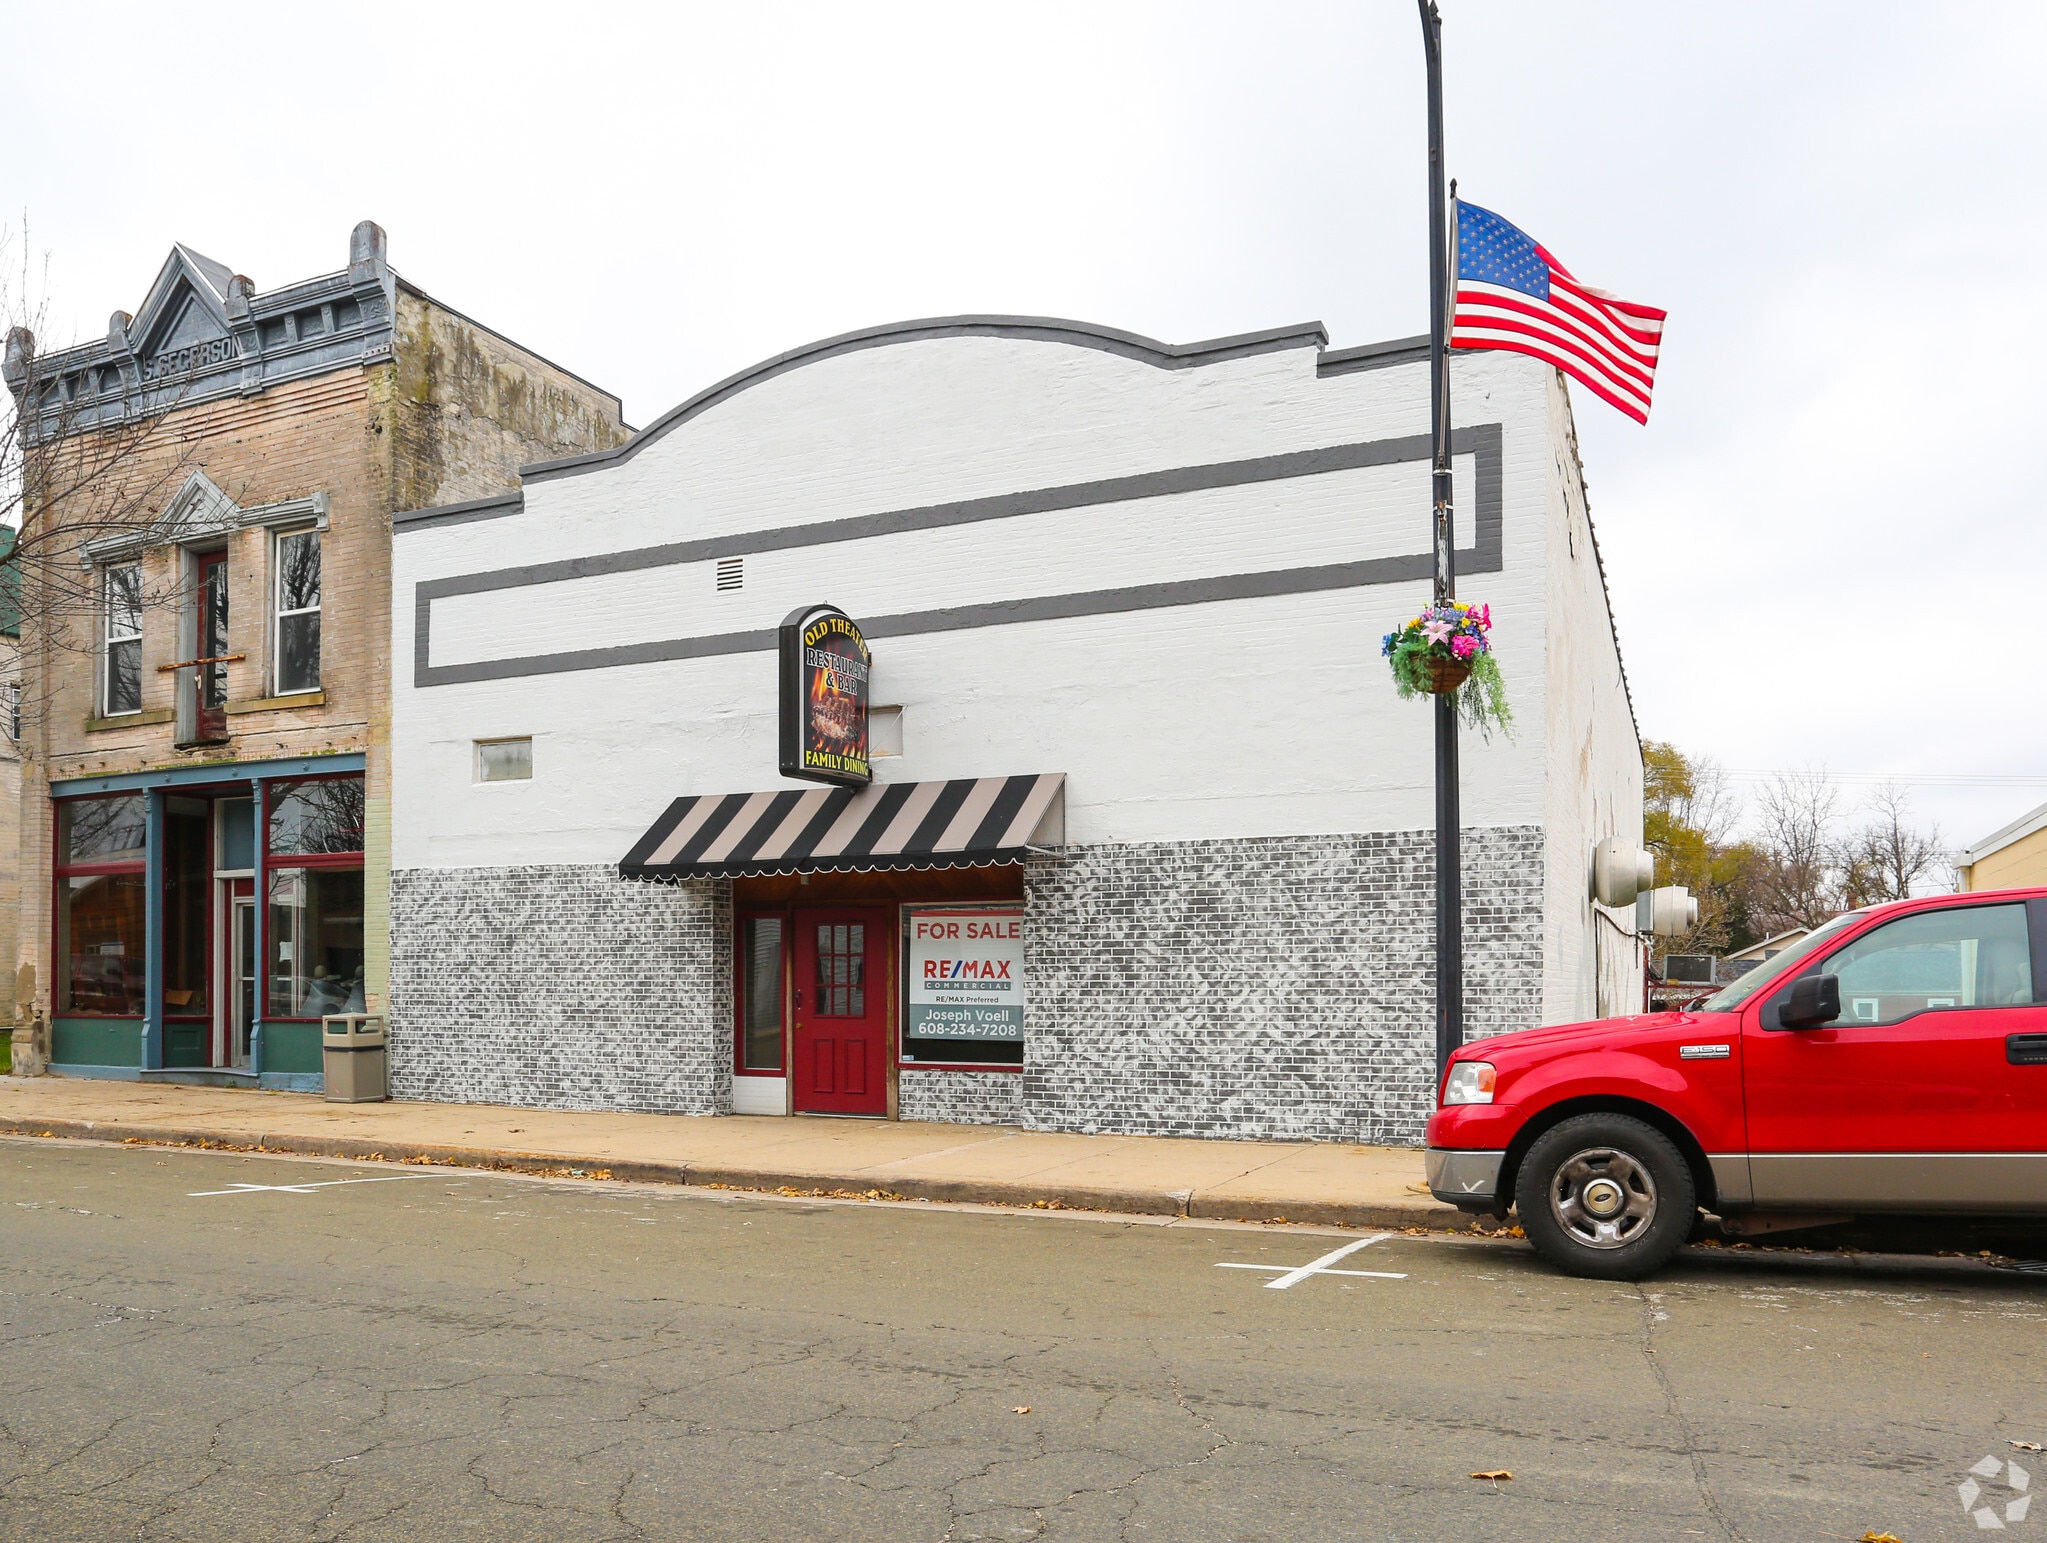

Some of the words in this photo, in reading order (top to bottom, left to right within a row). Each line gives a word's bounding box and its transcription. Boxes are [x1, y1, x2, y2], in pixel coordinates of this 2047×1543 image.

[805, 621, 828, 646] OLD
[830, 618, 868, 661] THEATER
[807, 647, 867, 682] RESTAURANT
[825, 671, 834, 688] &
[837, 674, 857, 695] BAR
[806, 750, 841, 770] FAMILY
[844, 756, 868, 776] DINING
[917, 923, 959, 939] FOR
[967, 922, 1020, 938] SALE
[924, 960, 1011, 978] RE/MAX
[926, 1010, 971, 1022] Joseph
[976, 1010, 1008, 1021] Voell
[919, 1023, 1016, 1036] 608-234-7208
